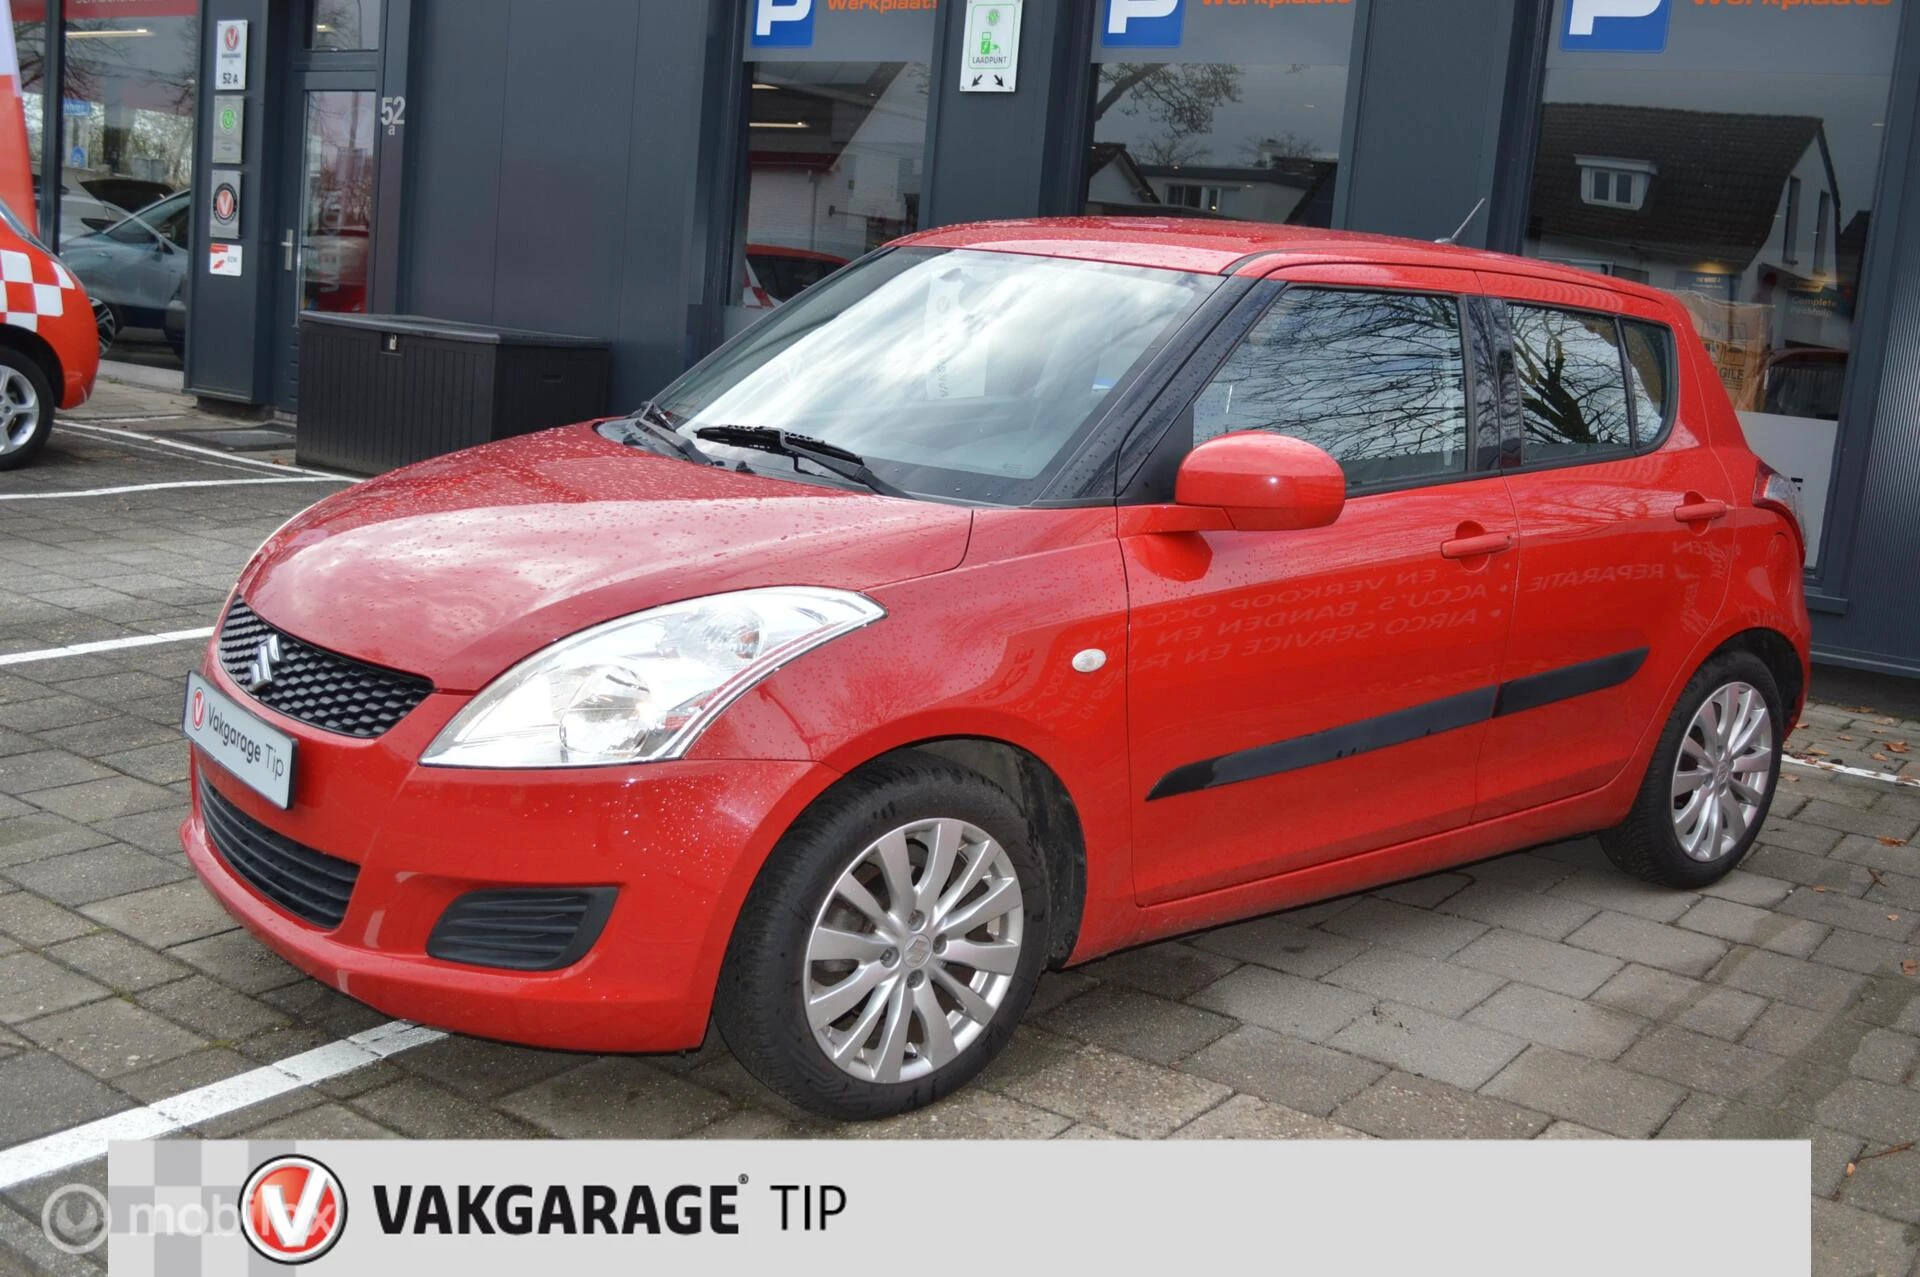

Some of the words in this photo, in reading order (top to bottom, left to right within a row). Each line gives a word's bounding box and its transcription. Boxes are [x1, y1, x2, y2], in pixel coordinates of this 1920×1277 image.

[972, 56, 1007, 64] LAADPUNT
[222, 72, 232, 85] 52
[381, 96, 405, 125] 52
[388, 125, 395, 136] a
[1719, 367, 1744, 379] GILE
[208, 703, 261, 764] Vakgarage
[265, 743, 285, 781] Tip
